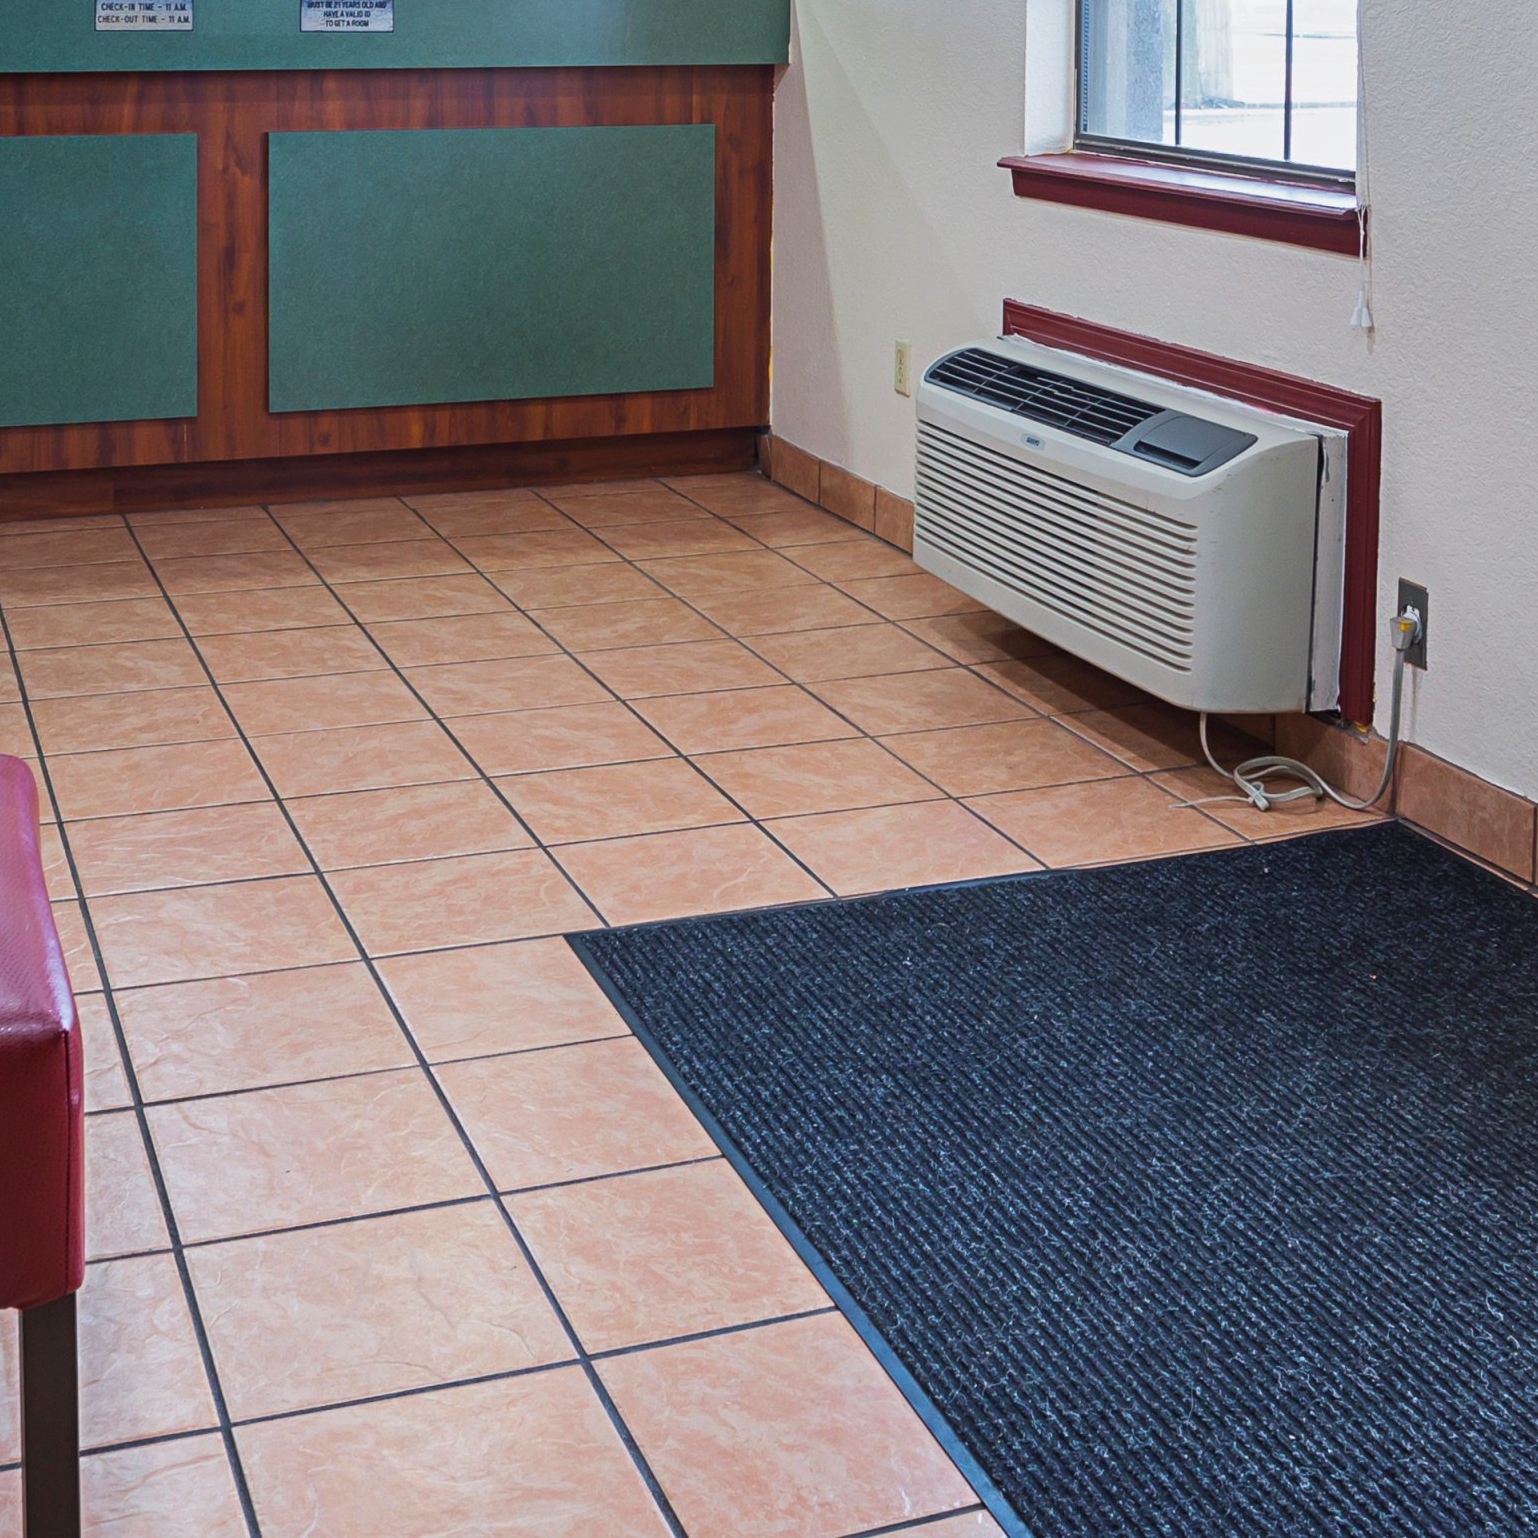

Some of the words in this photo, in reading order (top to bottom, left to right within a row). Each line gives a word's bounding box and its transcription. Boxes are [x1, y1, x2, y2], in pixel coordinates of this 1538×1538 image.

[100, 3, 136, 11] CHECK-IN
[139, 3, 155, 11] TIME
[165, 3, 171, 11] 11
[323, 10, 339, 18] HAVE
[345, 10, 363, 18] VALID
[364, 10, 371, 18] ID
[97, 15, 138, 23] CHECK-OUT
[141, 15, 158, 23] TIME
[168, 15, 175, 23] 11
